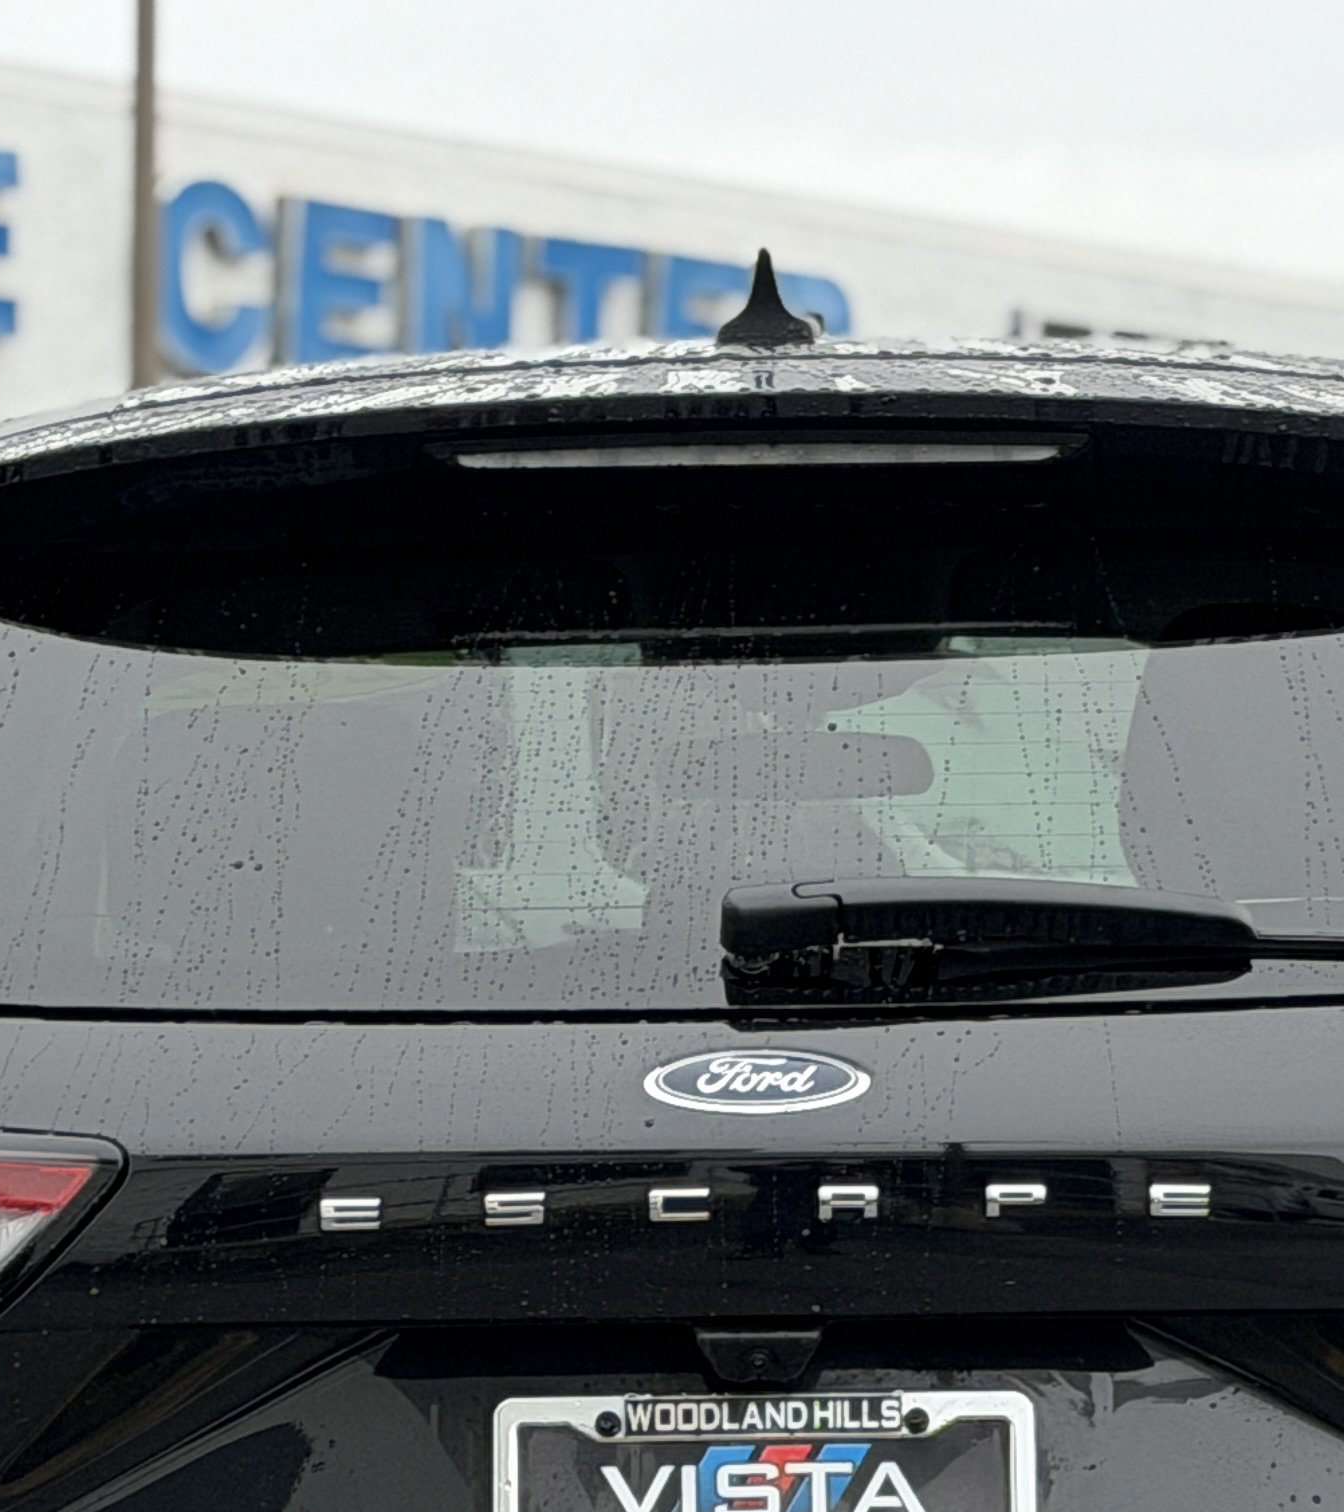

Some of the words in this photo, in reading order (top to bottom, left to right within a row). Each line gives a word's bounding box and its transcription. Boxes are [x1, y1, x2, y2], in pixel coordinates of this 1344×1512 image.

[696, 1056, 817, 1094] Ford
[320, 1184, 1211, 1231] ESCAPE
[626, 1401, 808, 1432] WOODLAND
[813, 1400, 902, 1430] HILLS
